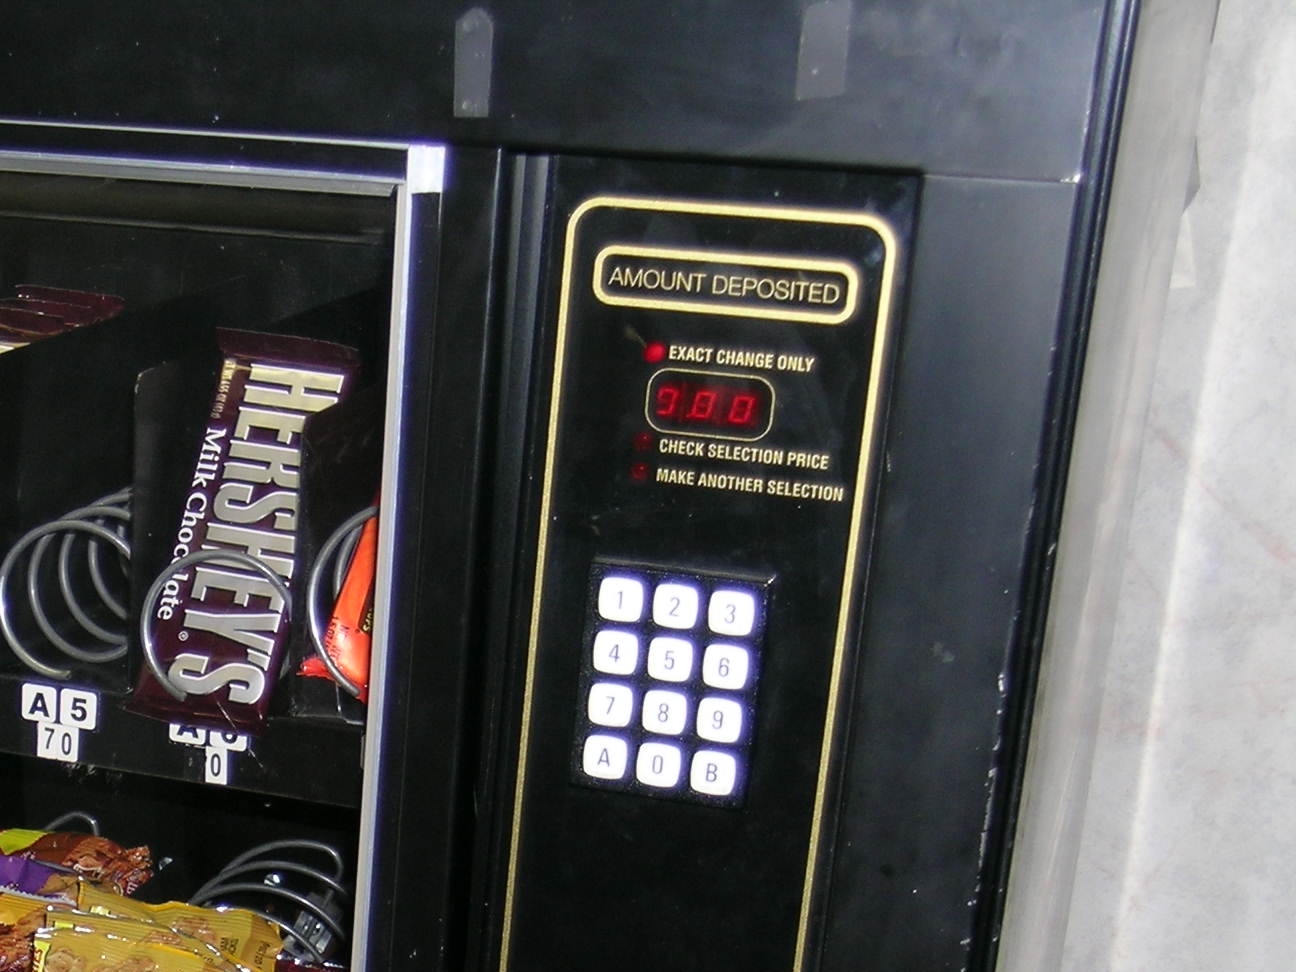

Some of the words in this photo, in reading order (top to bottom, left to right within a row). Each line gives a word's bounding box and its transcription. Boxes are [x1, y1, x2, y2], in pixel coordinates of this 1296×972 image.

[608, 266, 706, 294] AMOUNT
[711, 274, 841, 305] DEPOSITED
[668, 345, 714, 364] EXACT
[716, 348, 774, 370] CHANGE
[777, 354, 816, 373] ONLY
[191, 427, 228, 489] Milk
[659, 438, 705, 457] CHECK
[707, 443, 783, 466] SELECTION
[786, 451, 830, 470] PRICE
[656, 467, 695, 486] MAKE
[697, 472, 764, 494] ANOTHER
[766, 479, 844, 502] SELECTION
[168, 363, 345, 705] HERSHEY'S
[157, 492, 208, 621] Choclate
[44, 727, 72, 756] 70
